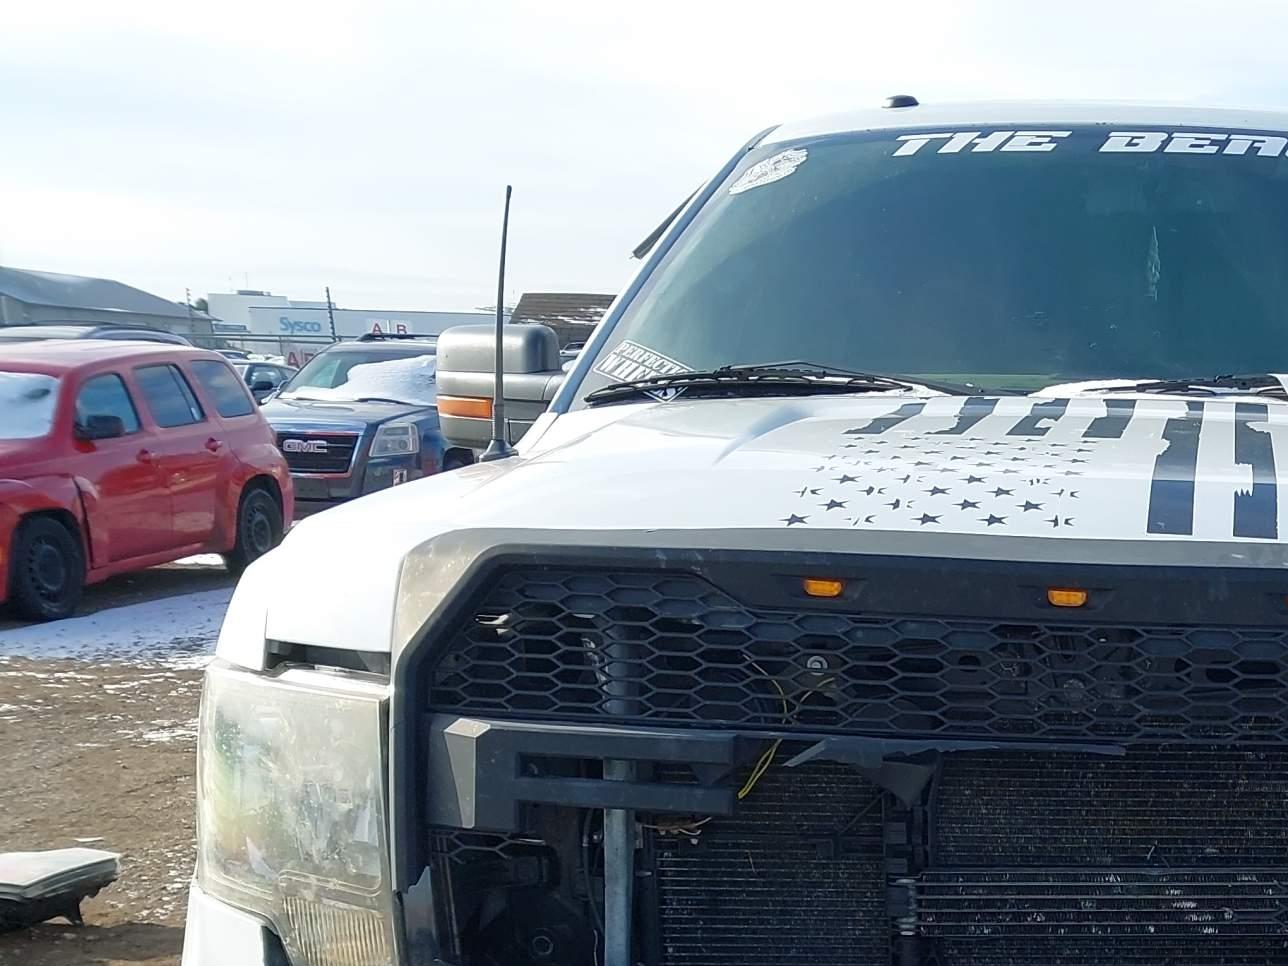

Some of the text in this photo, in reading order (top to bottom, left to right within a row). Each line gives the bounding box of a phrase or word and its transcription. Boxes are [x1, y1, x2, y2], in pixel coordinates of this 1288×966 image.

[892, 131, 1072, 157] THE
[279, 317, 321, 334] Sysco
[372, 322, 383, 335] A
[614, 341, 688, 375] PERFECTI
[282, 439, 328, 453] GMC
